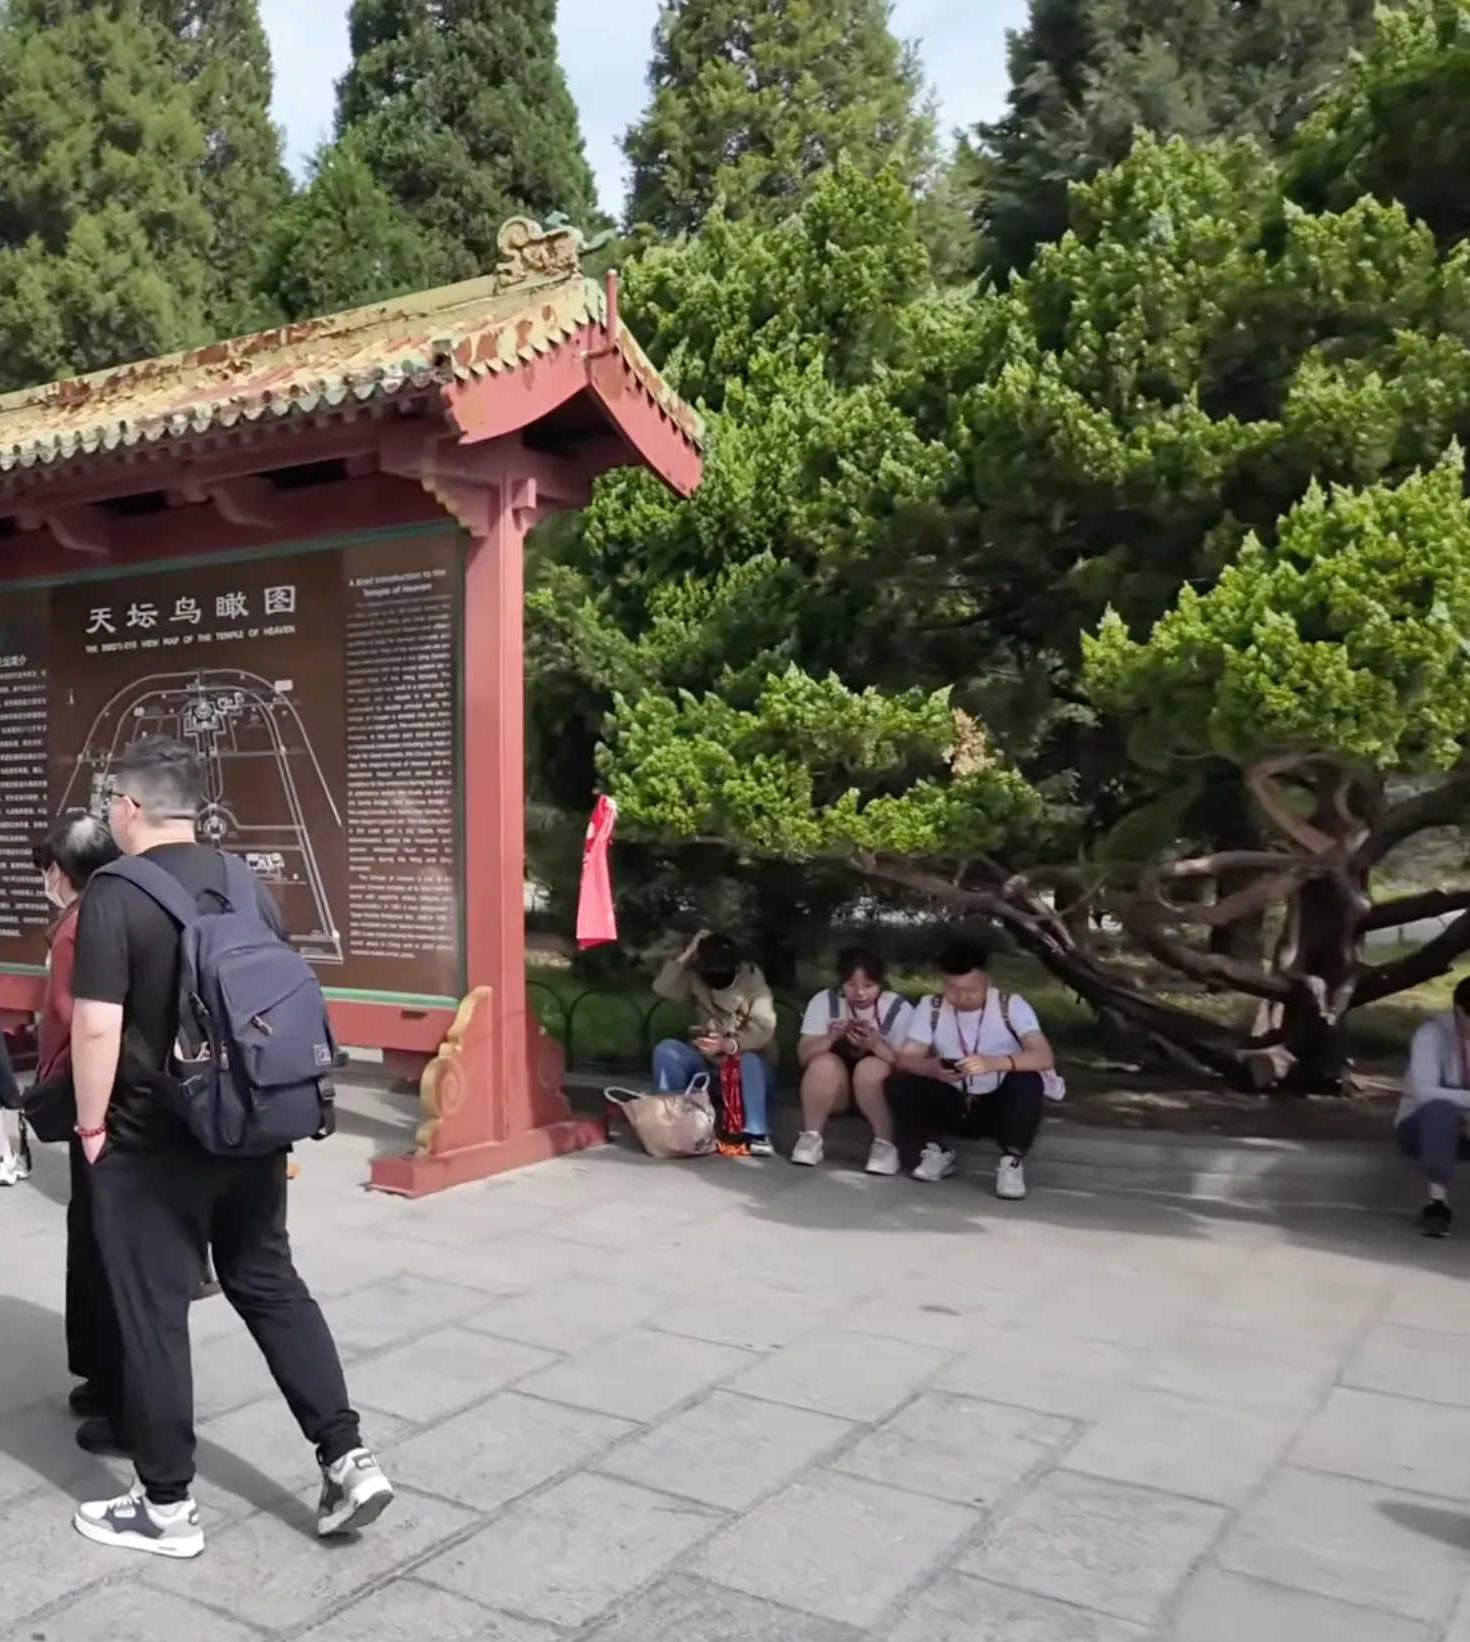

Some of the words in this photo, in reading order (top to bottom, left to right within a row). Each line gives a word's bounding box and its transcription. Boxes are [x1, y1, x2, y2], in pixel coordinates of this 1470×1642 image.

[85, 585, 296, 634] 天坛鸟瞰图
[141, 638, 159, 648] VIEW
[162, 637, 180, 646] MAP
[183, 635, 194, 644] OF
[197, 634, 212, 642] THE
[216, 629, 244, 641] TEMPLE
[248, 628, 259, 637] OF
[263, 625, 296, 636] HEAVEN
